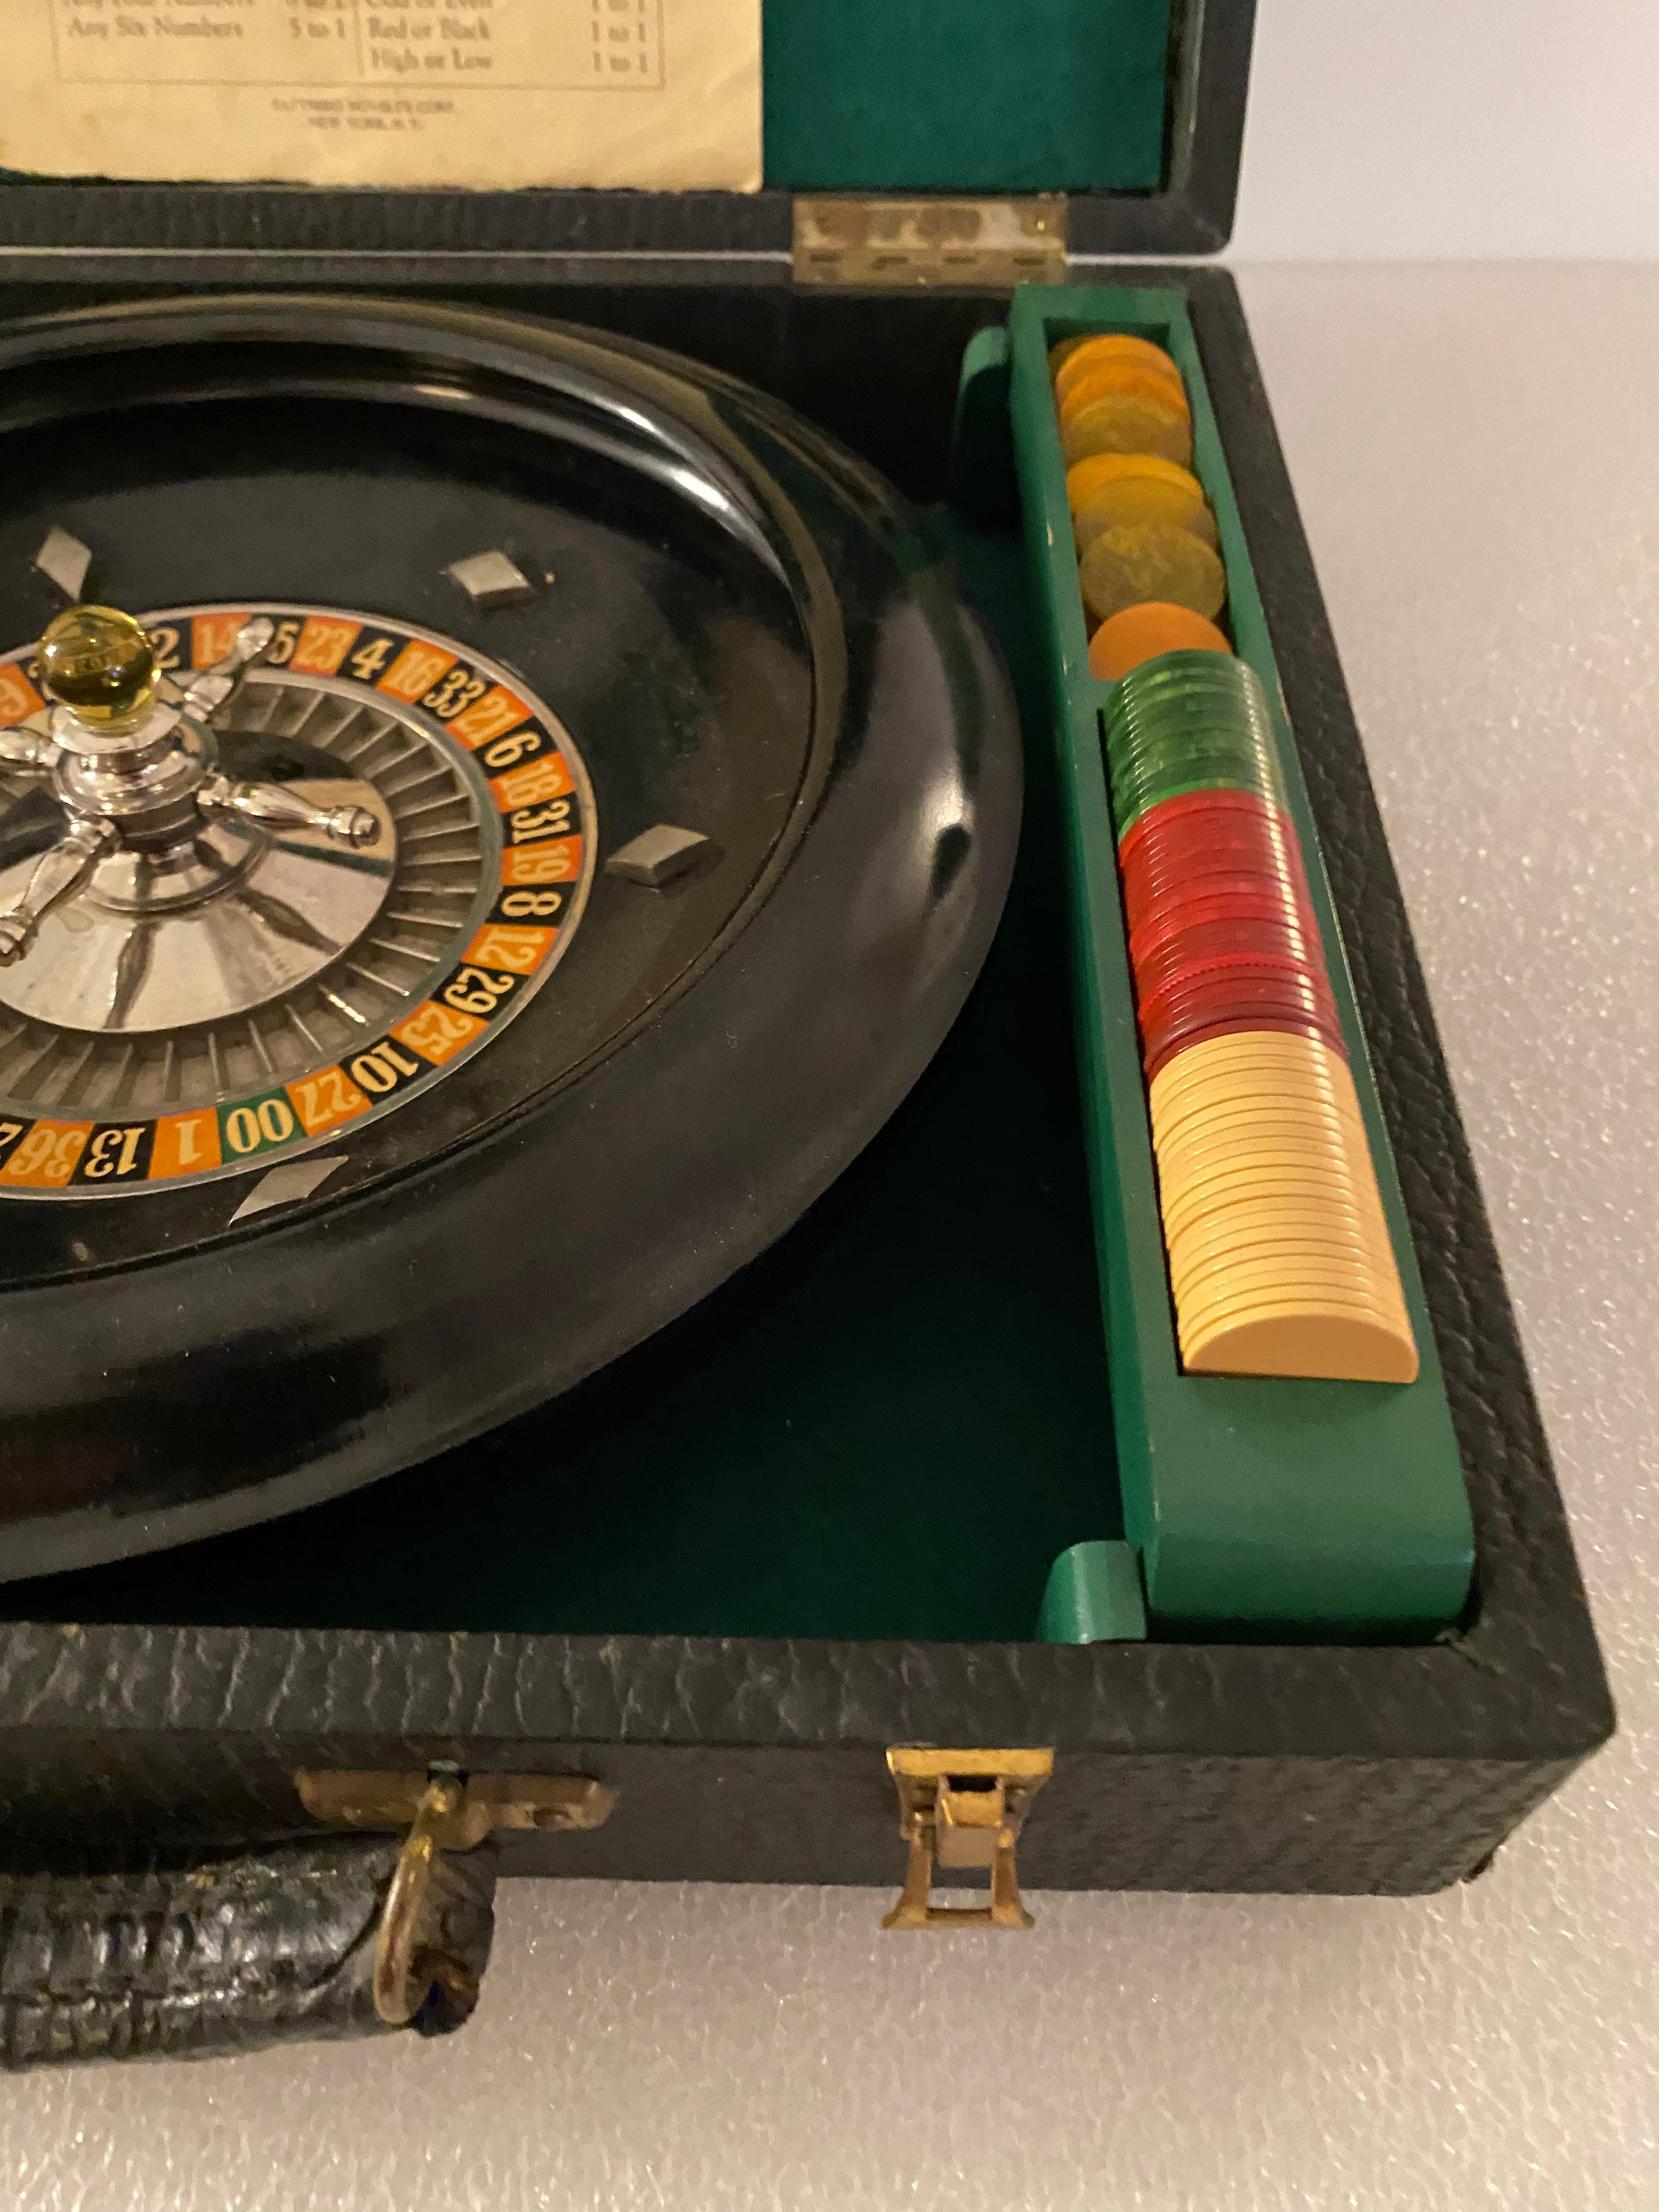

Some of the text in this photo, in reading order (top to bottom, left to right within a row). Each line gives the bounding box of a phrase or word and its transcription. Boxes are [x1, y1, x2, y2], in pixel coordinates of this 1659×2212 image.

[68, 14, 244, 40] Any Six Numbers
[290, 17, 345, 38] 5 to 1
[369, 16, 407, 38] Red
[592, 21, 646, 43] 1 to 1
[371, 47, 492, 73] High or Low
[593, 52, 647, 74] 1 to 1
[149, 628, 180, 669] 2
[295, 624, 353, 670] 23
[352, 637, 395, 680] 4
[385, 653, 441, 696] 16
[424, 670, 486, 718] 33
[462, 695, 519, 744] 21
[484, 731, 541, 768] 6
[498, 763, 562, 807] 18
[511, 801, 571, 844] 31
[511, 845, 571, 883] 19
[501, 891, 562, 917] 8
[473, 927, 545, 965] 12
[444, 967, 515, 1014] 29
[401, 1012, 473, 1057] 25
[351, 1041, 420, 1093] 10
[295, 1070, 363, 1129] 27
[176, 1118, 203, 1165] 1
[225, 1098, 295, 1153] 00
[7, 1128, 88, 1178] 36
[84, 1127, 146, 1178] 13
